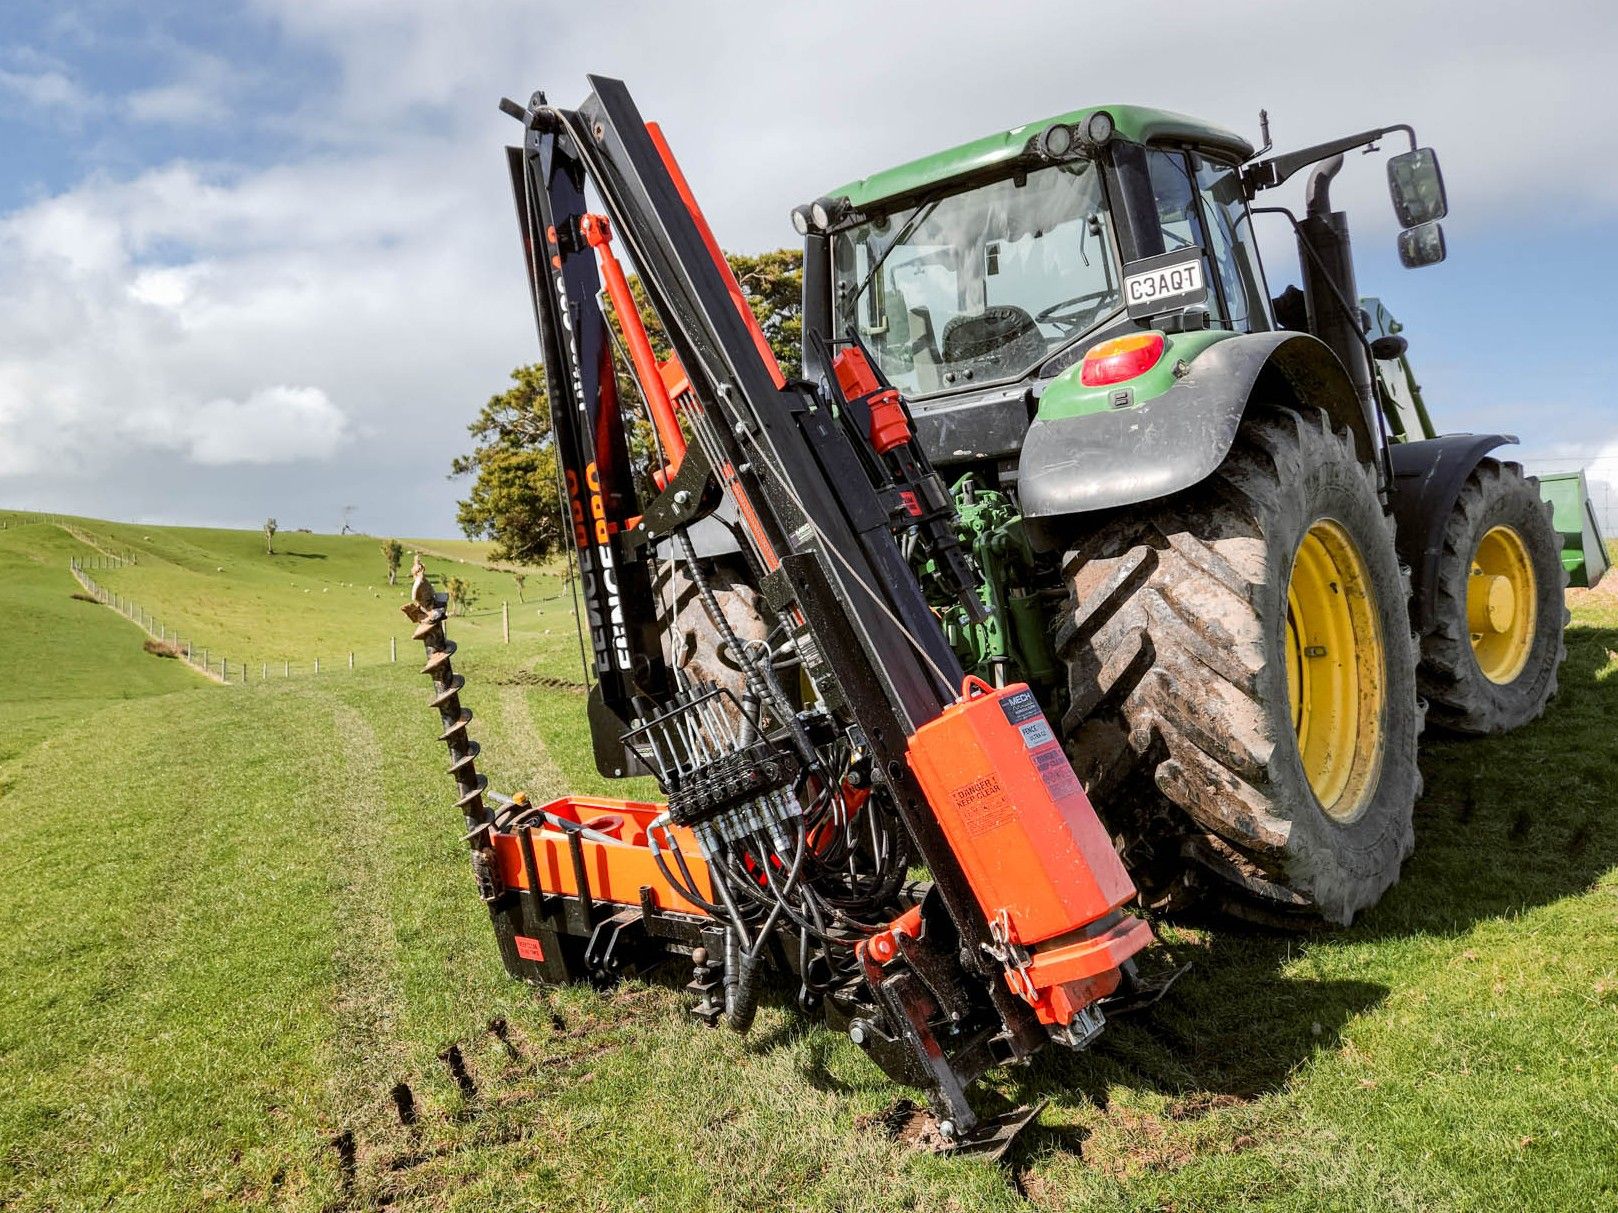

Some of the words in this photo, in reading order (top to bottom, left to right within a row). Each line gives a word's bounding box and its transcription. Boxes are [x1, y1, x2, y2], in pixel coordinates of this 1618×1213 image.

[1130, 266, 1196, 301] C3AQT
[1008, 693, 1032, 706] MECH
[957, 779, 992, 799] DANGER
[976, 785, 1001, 800] CLEAR
